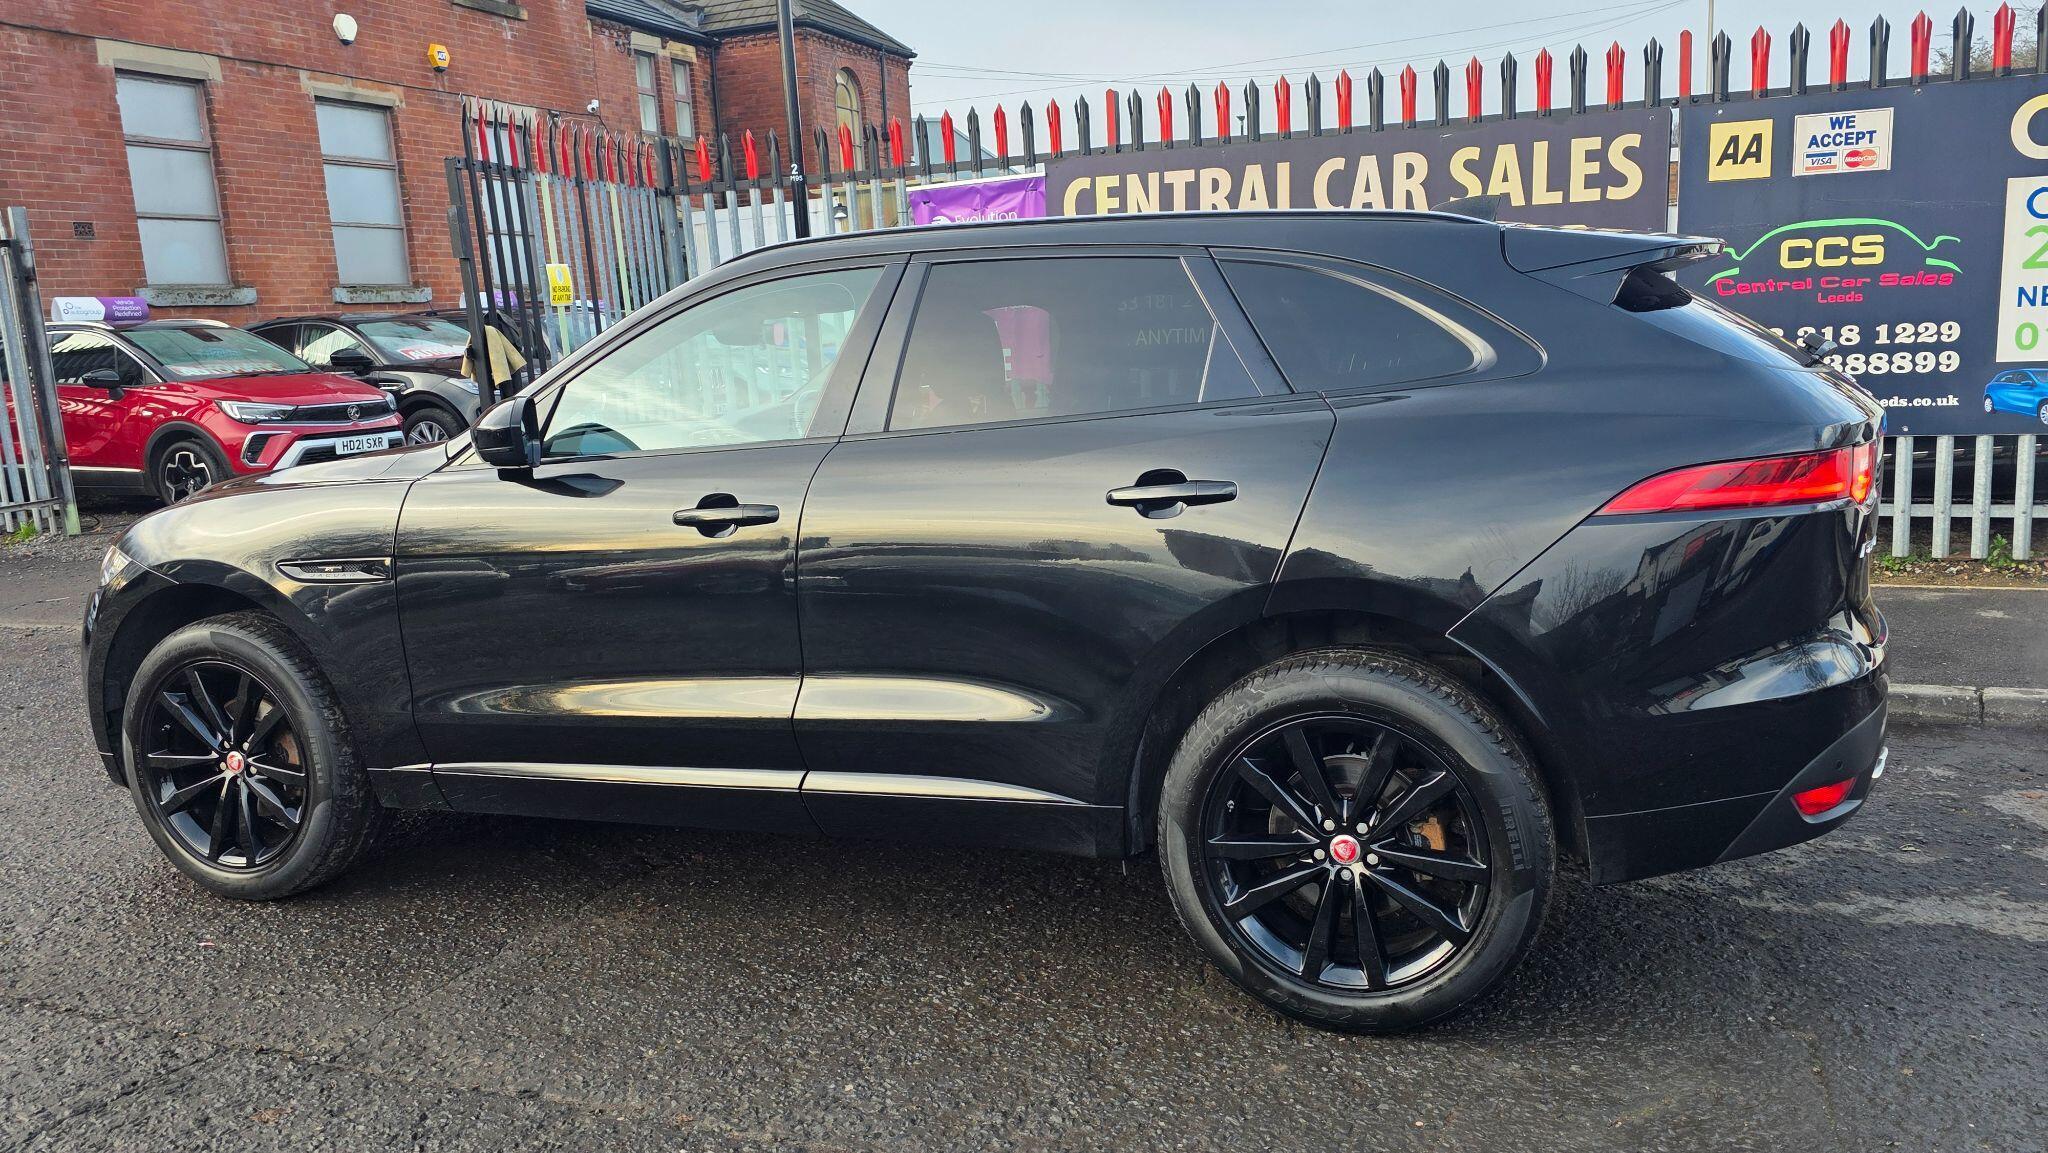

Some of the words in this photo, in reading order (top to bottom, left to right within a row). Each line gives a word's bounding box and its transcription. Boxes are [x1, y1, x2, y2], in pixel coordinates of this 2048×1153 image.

[1830, 115, 1857, 131] WE
[1808, 130, 1877, 149] ACCEPT
[1716, 132, 1763, 167] AA
[1811, 157, 1832, 166] VISA
[1845, 154, 1877, 163] MasterCard
[790, 163, 799, 175] 2
[1313, 151, 1430, 212] CAR
[1449, 133, 1643, 207] SALES
[1779, 234, 1885, 269] CCS
[1716, 277, 1813, 297] Central
[1820, 276, 1871, 289] Car
[1879, 271, 1954, 287] Sales
[1817, 291, 1864, 304] Leeds
[1875, 321, 1961, 345] 1229
[1876, 394, 1960, 408] eds.co.uk
[342, 439, 365, 451] HD21
[366, 436, 383, 449] SXR
